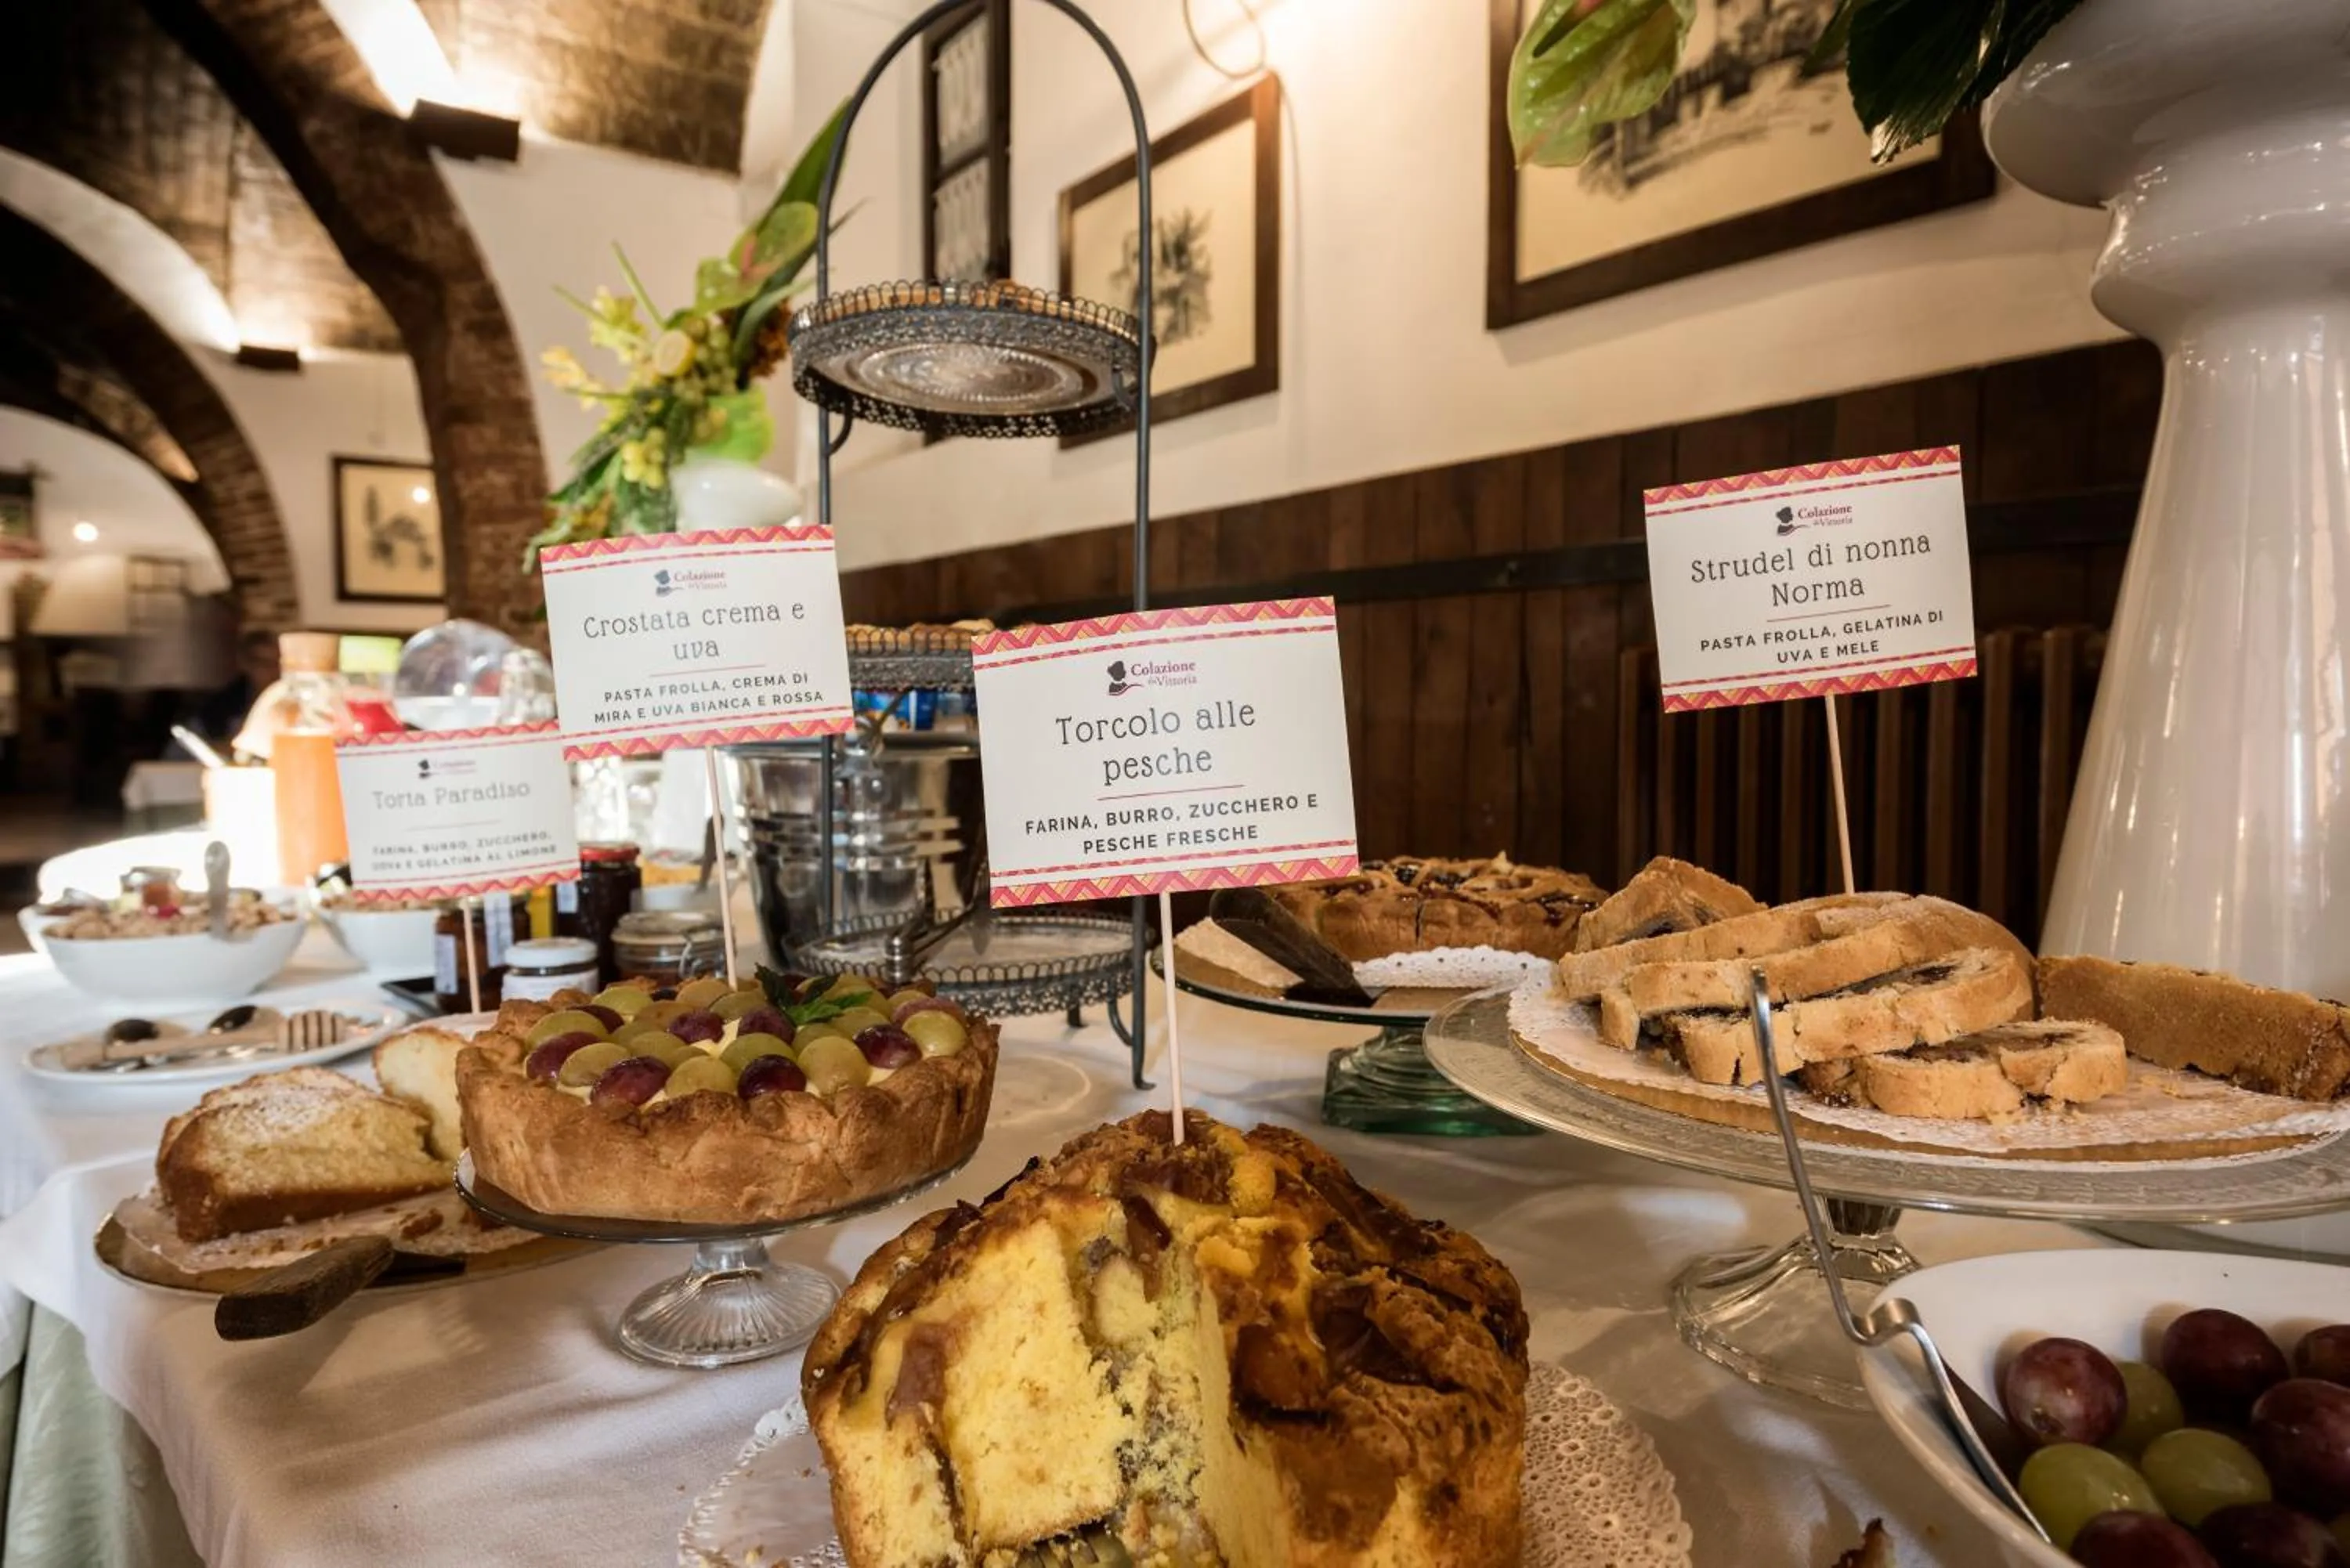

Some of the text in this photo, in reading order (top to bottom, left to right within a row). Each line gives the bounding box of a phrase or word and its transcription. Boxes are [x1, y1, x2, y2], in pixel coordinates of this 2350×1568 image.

[1798, 504, 1853, 519] Colazione
[1691, 534, 1931, 583] Strudel di nonna
[1772, 577, 1864, 607] Norma
[584, 602, 805, 639] Crostata crema e
[1700, 610, 1943, 651] PASTA FROLLA, GELATINA DI
[674, 640, 720, 660] uva
[1777, 641, 1879, 663] UVA E MELE
[1130, 660, 1196, 677] Colazione
[604, 673, 808, 703] PASTA FROLLA, CREMA DI
[594, 691, 823, 724] MIRA E UVA BIANCA E ROSSA
[1056, 700, 1256, 745] Torcolo alle
[1103, 747, 1213, 786] pesche
[435, 782, 530, 805] Paradiso
[1025, 793, 1318, 835] FARINA, BURRO, ZUCCHERO E
[508, 844, 557, 860] LIMONE
[1083, 826, 1259, 854] PESCHE FRESCHE
